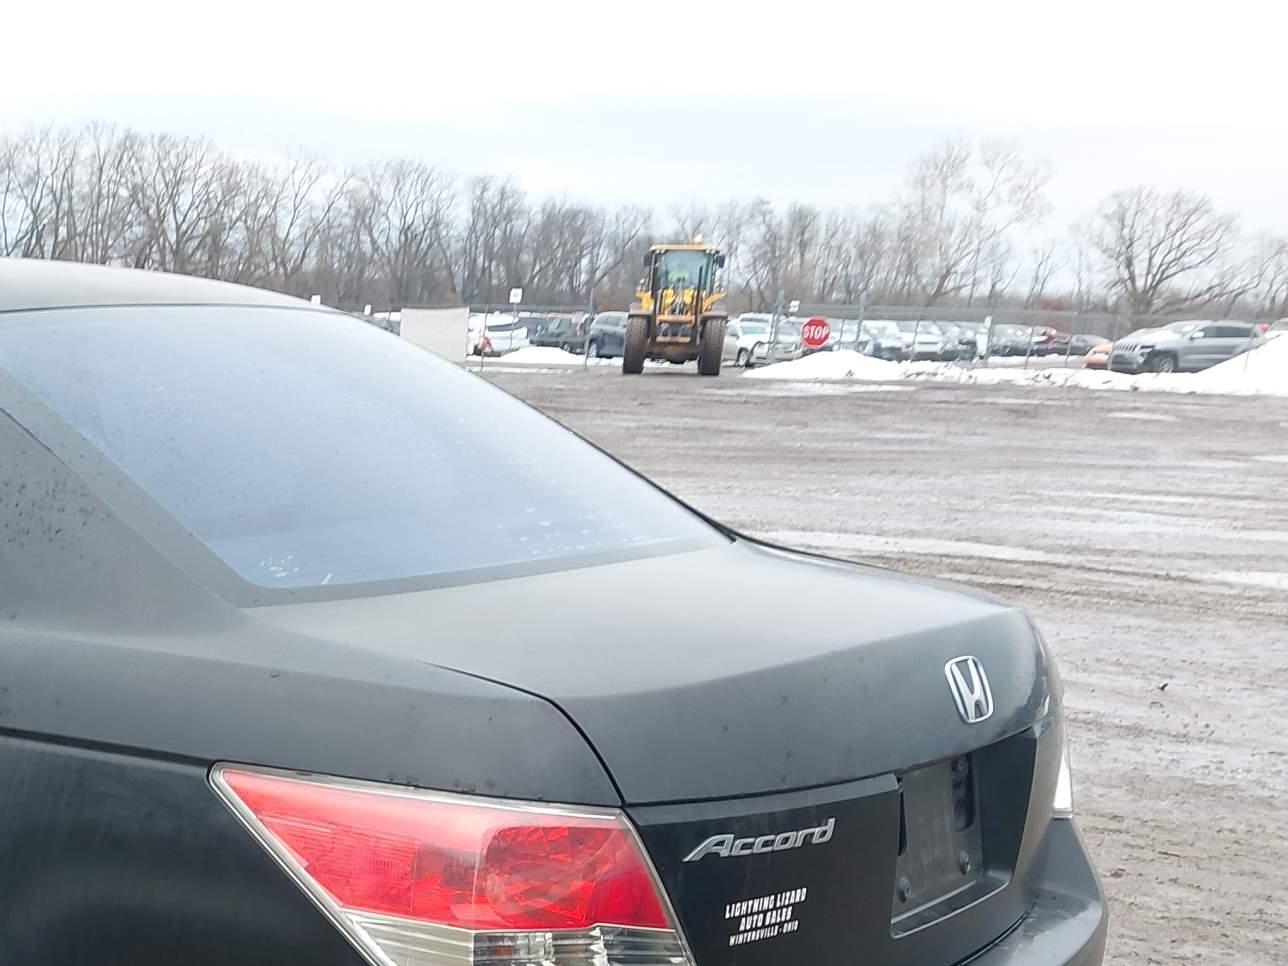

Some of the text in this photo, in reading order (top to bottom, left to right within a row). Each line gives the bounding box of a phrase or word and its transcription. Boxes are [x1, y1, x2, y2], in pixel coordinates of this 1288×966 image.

[804, 325, 829, 339] STOP
[682, 818, 836, 863] Accord
[725, 887, 807, 919] LIGHTNING LIZARD
[739, 906, 793, 931] AUTO SALES
[729, 925, 779, 946] WINTERSVILLE
[782, 920, 799, 933] OHIO
